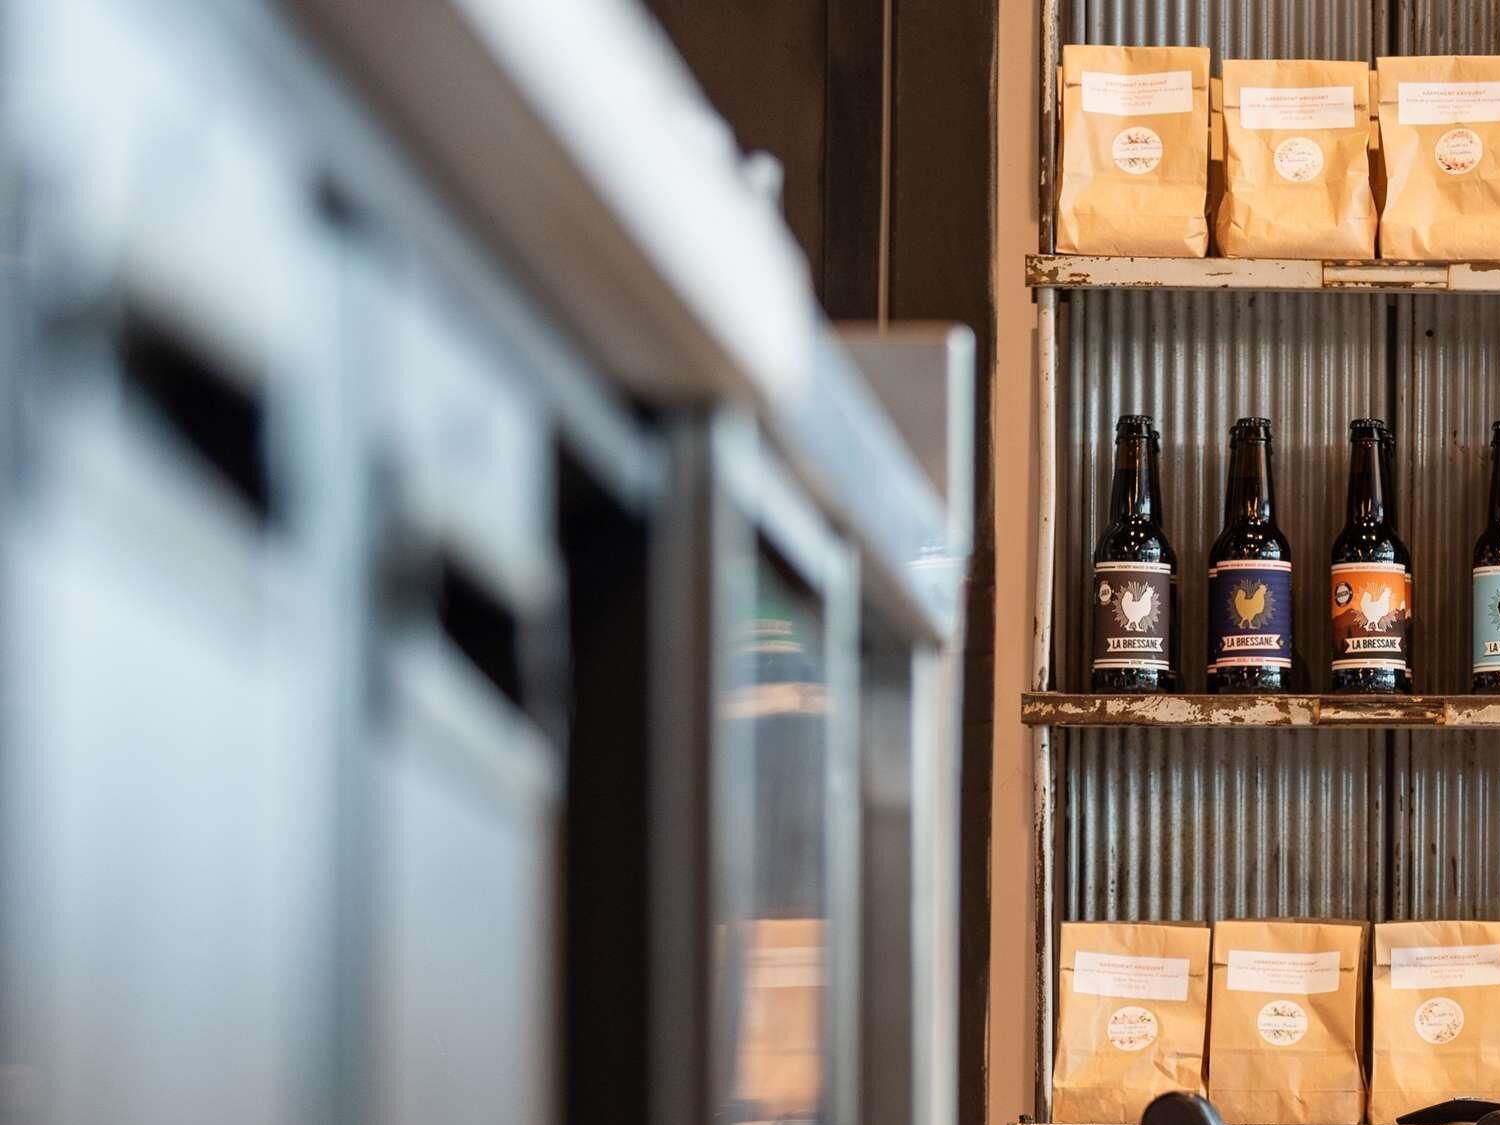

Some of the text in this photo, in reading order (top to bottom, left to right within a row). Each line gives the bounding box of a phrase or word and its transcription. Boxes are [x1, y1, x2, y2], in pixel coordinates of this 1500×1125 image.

[1112, 639, 1158, 649] LA BRESSANE
[1226, 636, 1273, 648] LA BRESSANE
[1352, 638, 1397, 650] LA BRESSANE
[1489, 642, 1498, 652] LA
